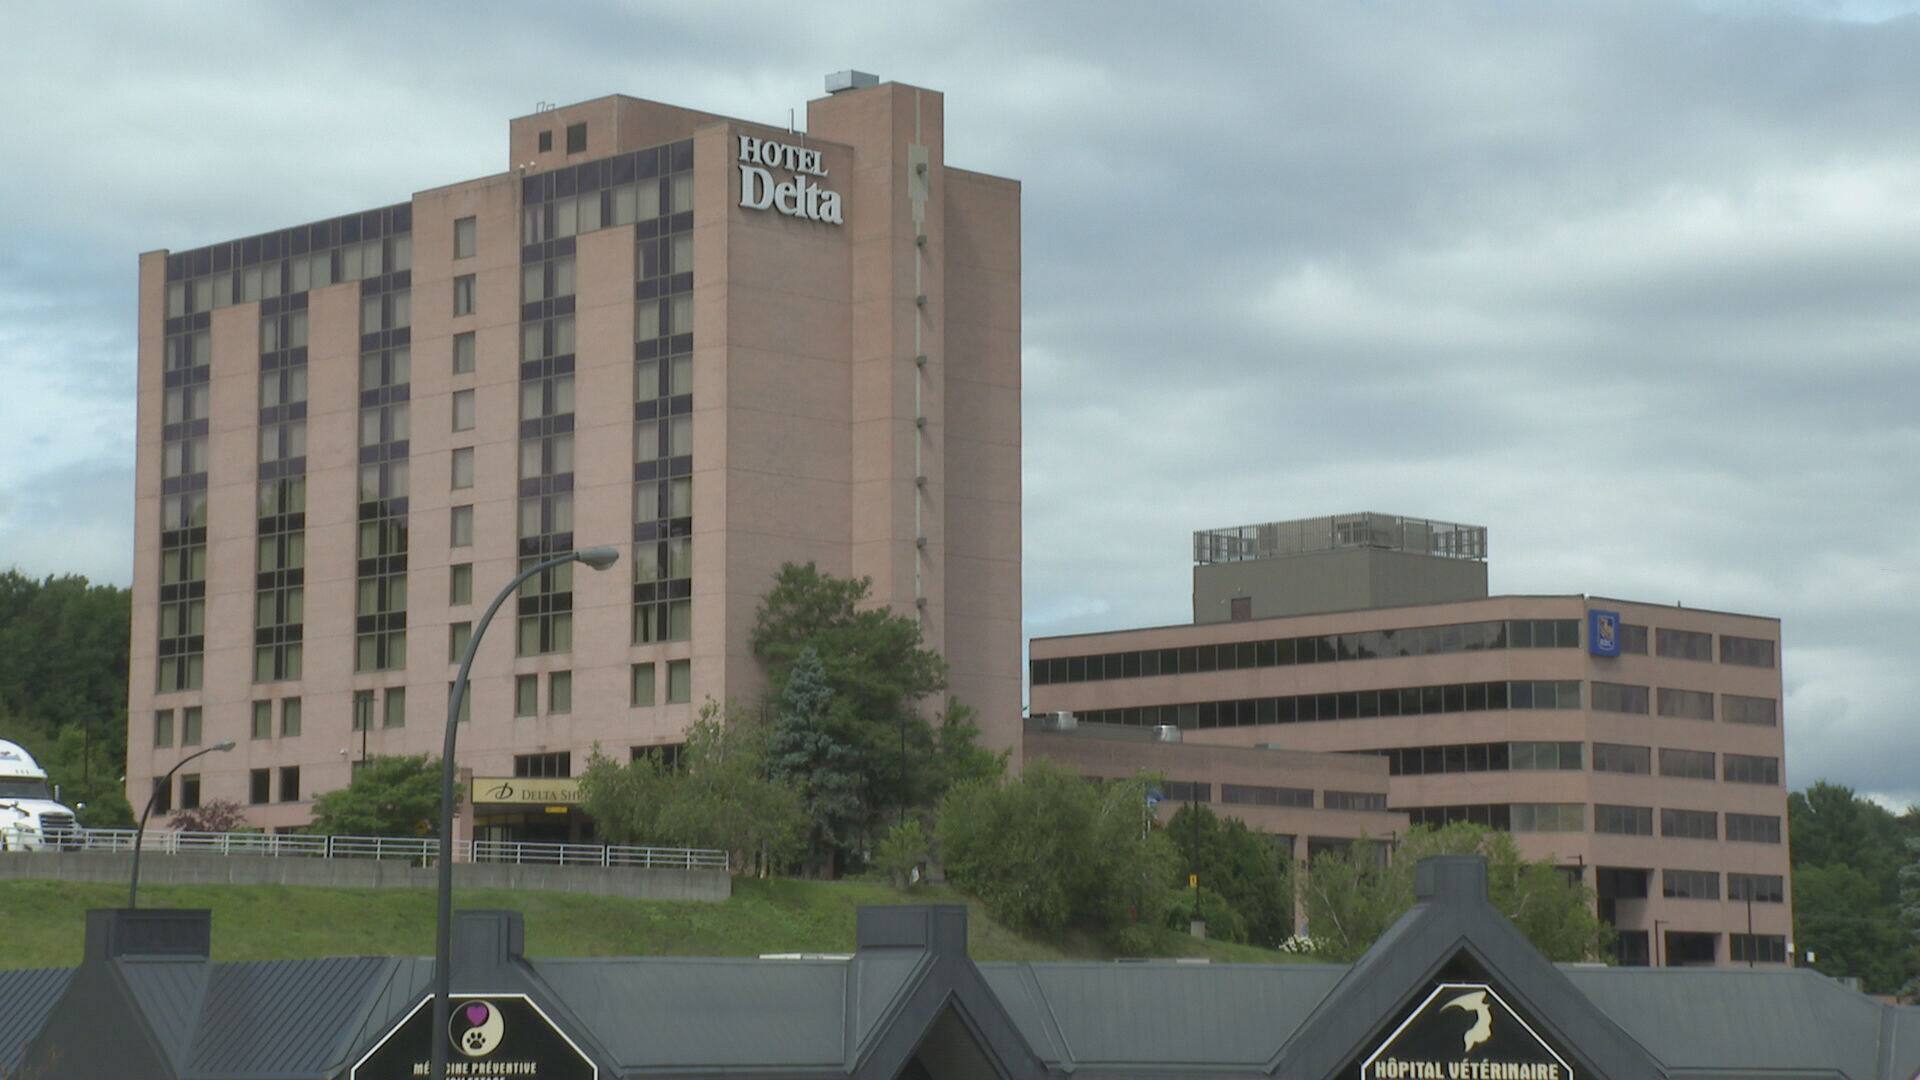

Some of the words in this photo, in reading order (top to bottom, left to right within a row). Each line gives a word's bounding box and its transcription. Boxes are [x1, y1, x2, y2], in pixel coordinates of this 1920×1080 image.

[739, 135, 829, 177] HOTEL
[739, 165, 844, 225] Delta
[522, 789, 557, 801] DELTA
[471, 1060, 537, 1074] PRÉVENTIVE
[1375, 1057, 1444, 1080] HÔPITAL
[1448, 1058, 1558, 1080] VÉTÉRINAIRE
